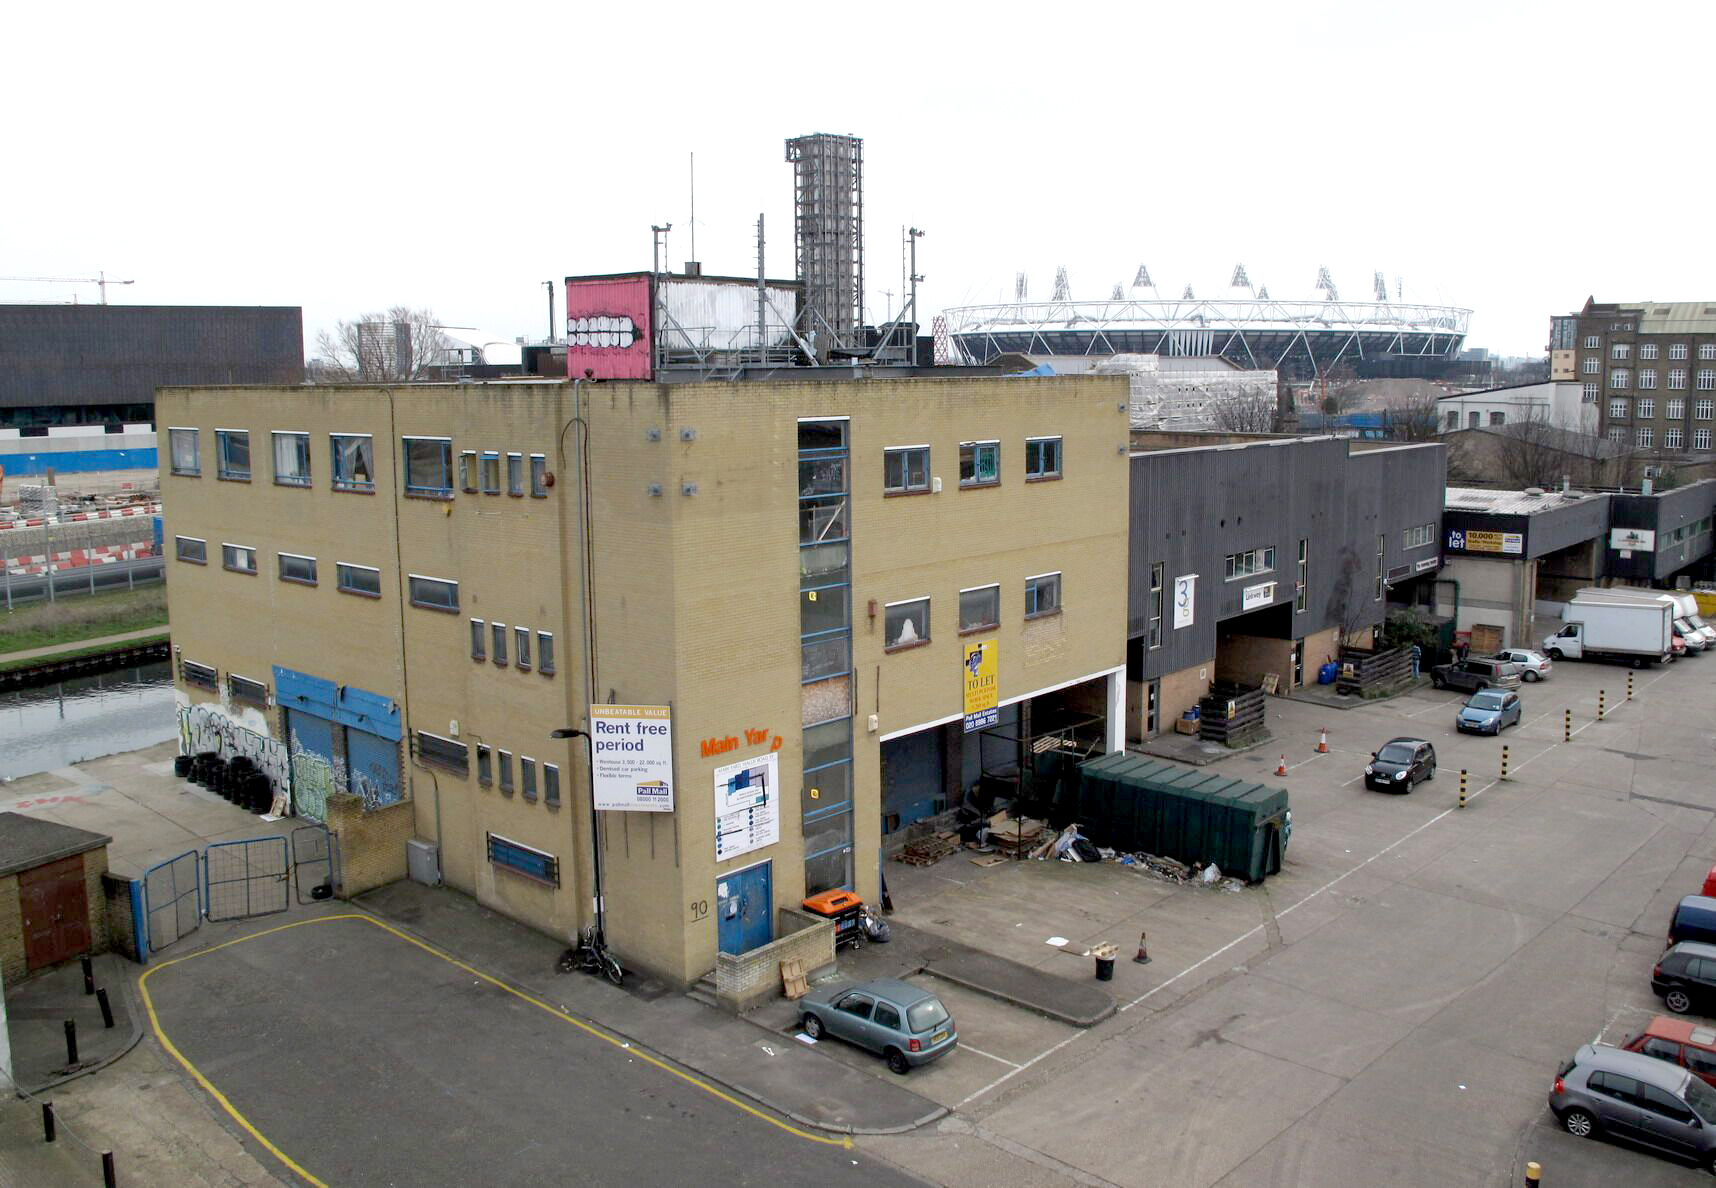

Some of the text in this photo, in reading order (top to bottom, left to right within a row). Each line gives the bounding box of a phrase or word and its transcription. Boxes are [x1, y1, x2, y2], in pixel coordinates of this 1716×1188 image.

[1452, 530, 1462, 539] to
[1449, 537, 1465, 549] let
[1177, 580, 1188, 607] 3
[967, 675, 994, 690] TO LET
[594, 708, 667, 717] UNBEATABLE VALUE
[596, 721, 667, 735] Rent free
[596, 738, 644, 754] period
[701, 736, 739, 759] Main
[691, 900, 708, 919] 90
